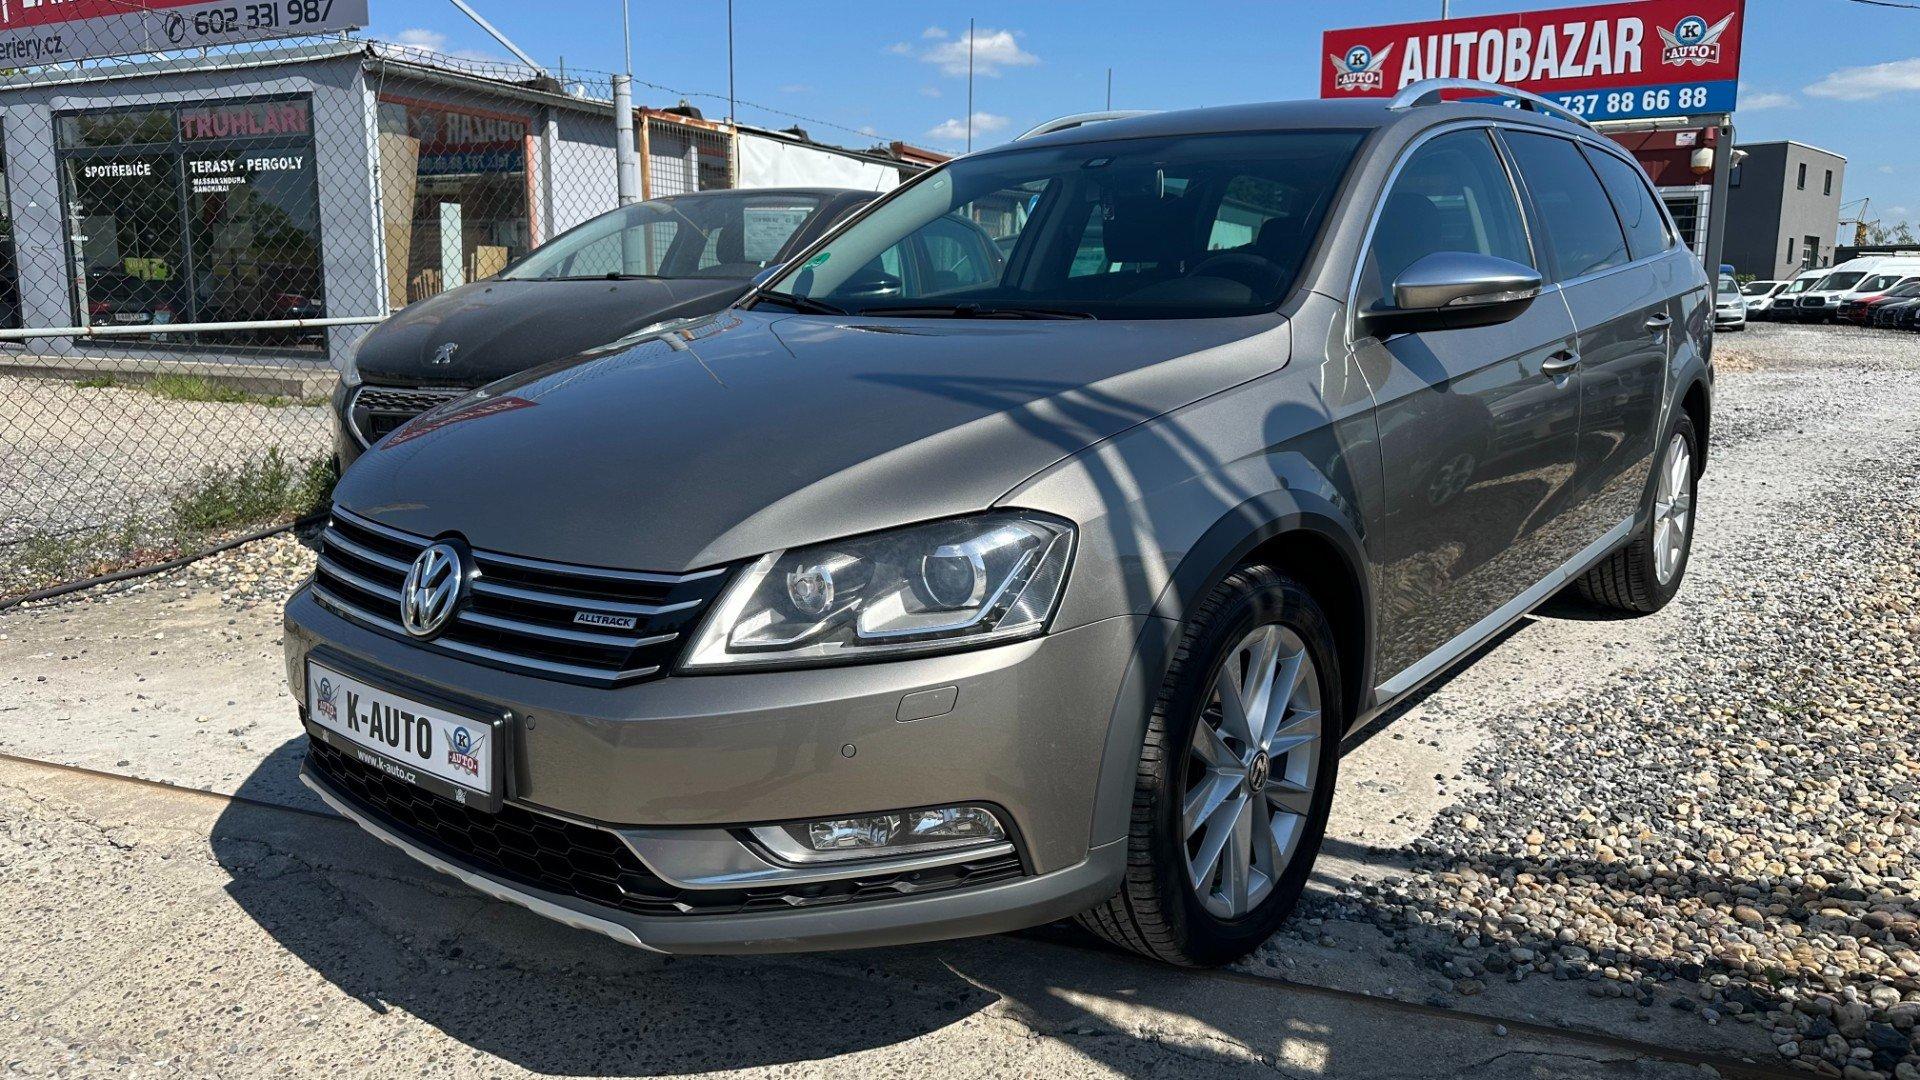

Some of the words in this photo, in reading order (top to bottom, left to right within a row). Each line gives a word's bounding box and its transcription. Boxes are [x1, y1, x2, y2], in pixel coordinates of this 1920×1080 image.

[195, 7, 239, 35] 602
[246, 2, 279, 30] 331
[287, 0, 333, 25] 987
[1682, 24, 1699, 38] K
[1352, 53, 1365, 66] K
[1397, 17, 1645, 90] AUTOBAZAR
[1670, 45, 1710, 59] AUTO
[1341, 72, 1374, 84] AUTO
[1559, 94, 1599, 115] 737
[1607, 92, 1634, 113] 88
[1642, 89, 1670, 111] 66
[1678, 87, 1707, 108] 88
[85, 161, 152, 177] SPOTŘEBIČE
[190, 159, 236, 173] TERASY
[246, 156, 304, 171] PERGOLY
[577, 613, 631, 627] ALLTRACK
[346, 690, 432, 760] K-AUTO
[457, 733, 467, 747] K
[357, 750, 417, 784] www.k-auto.cz
[451, 752, 474, 770] AUTO
